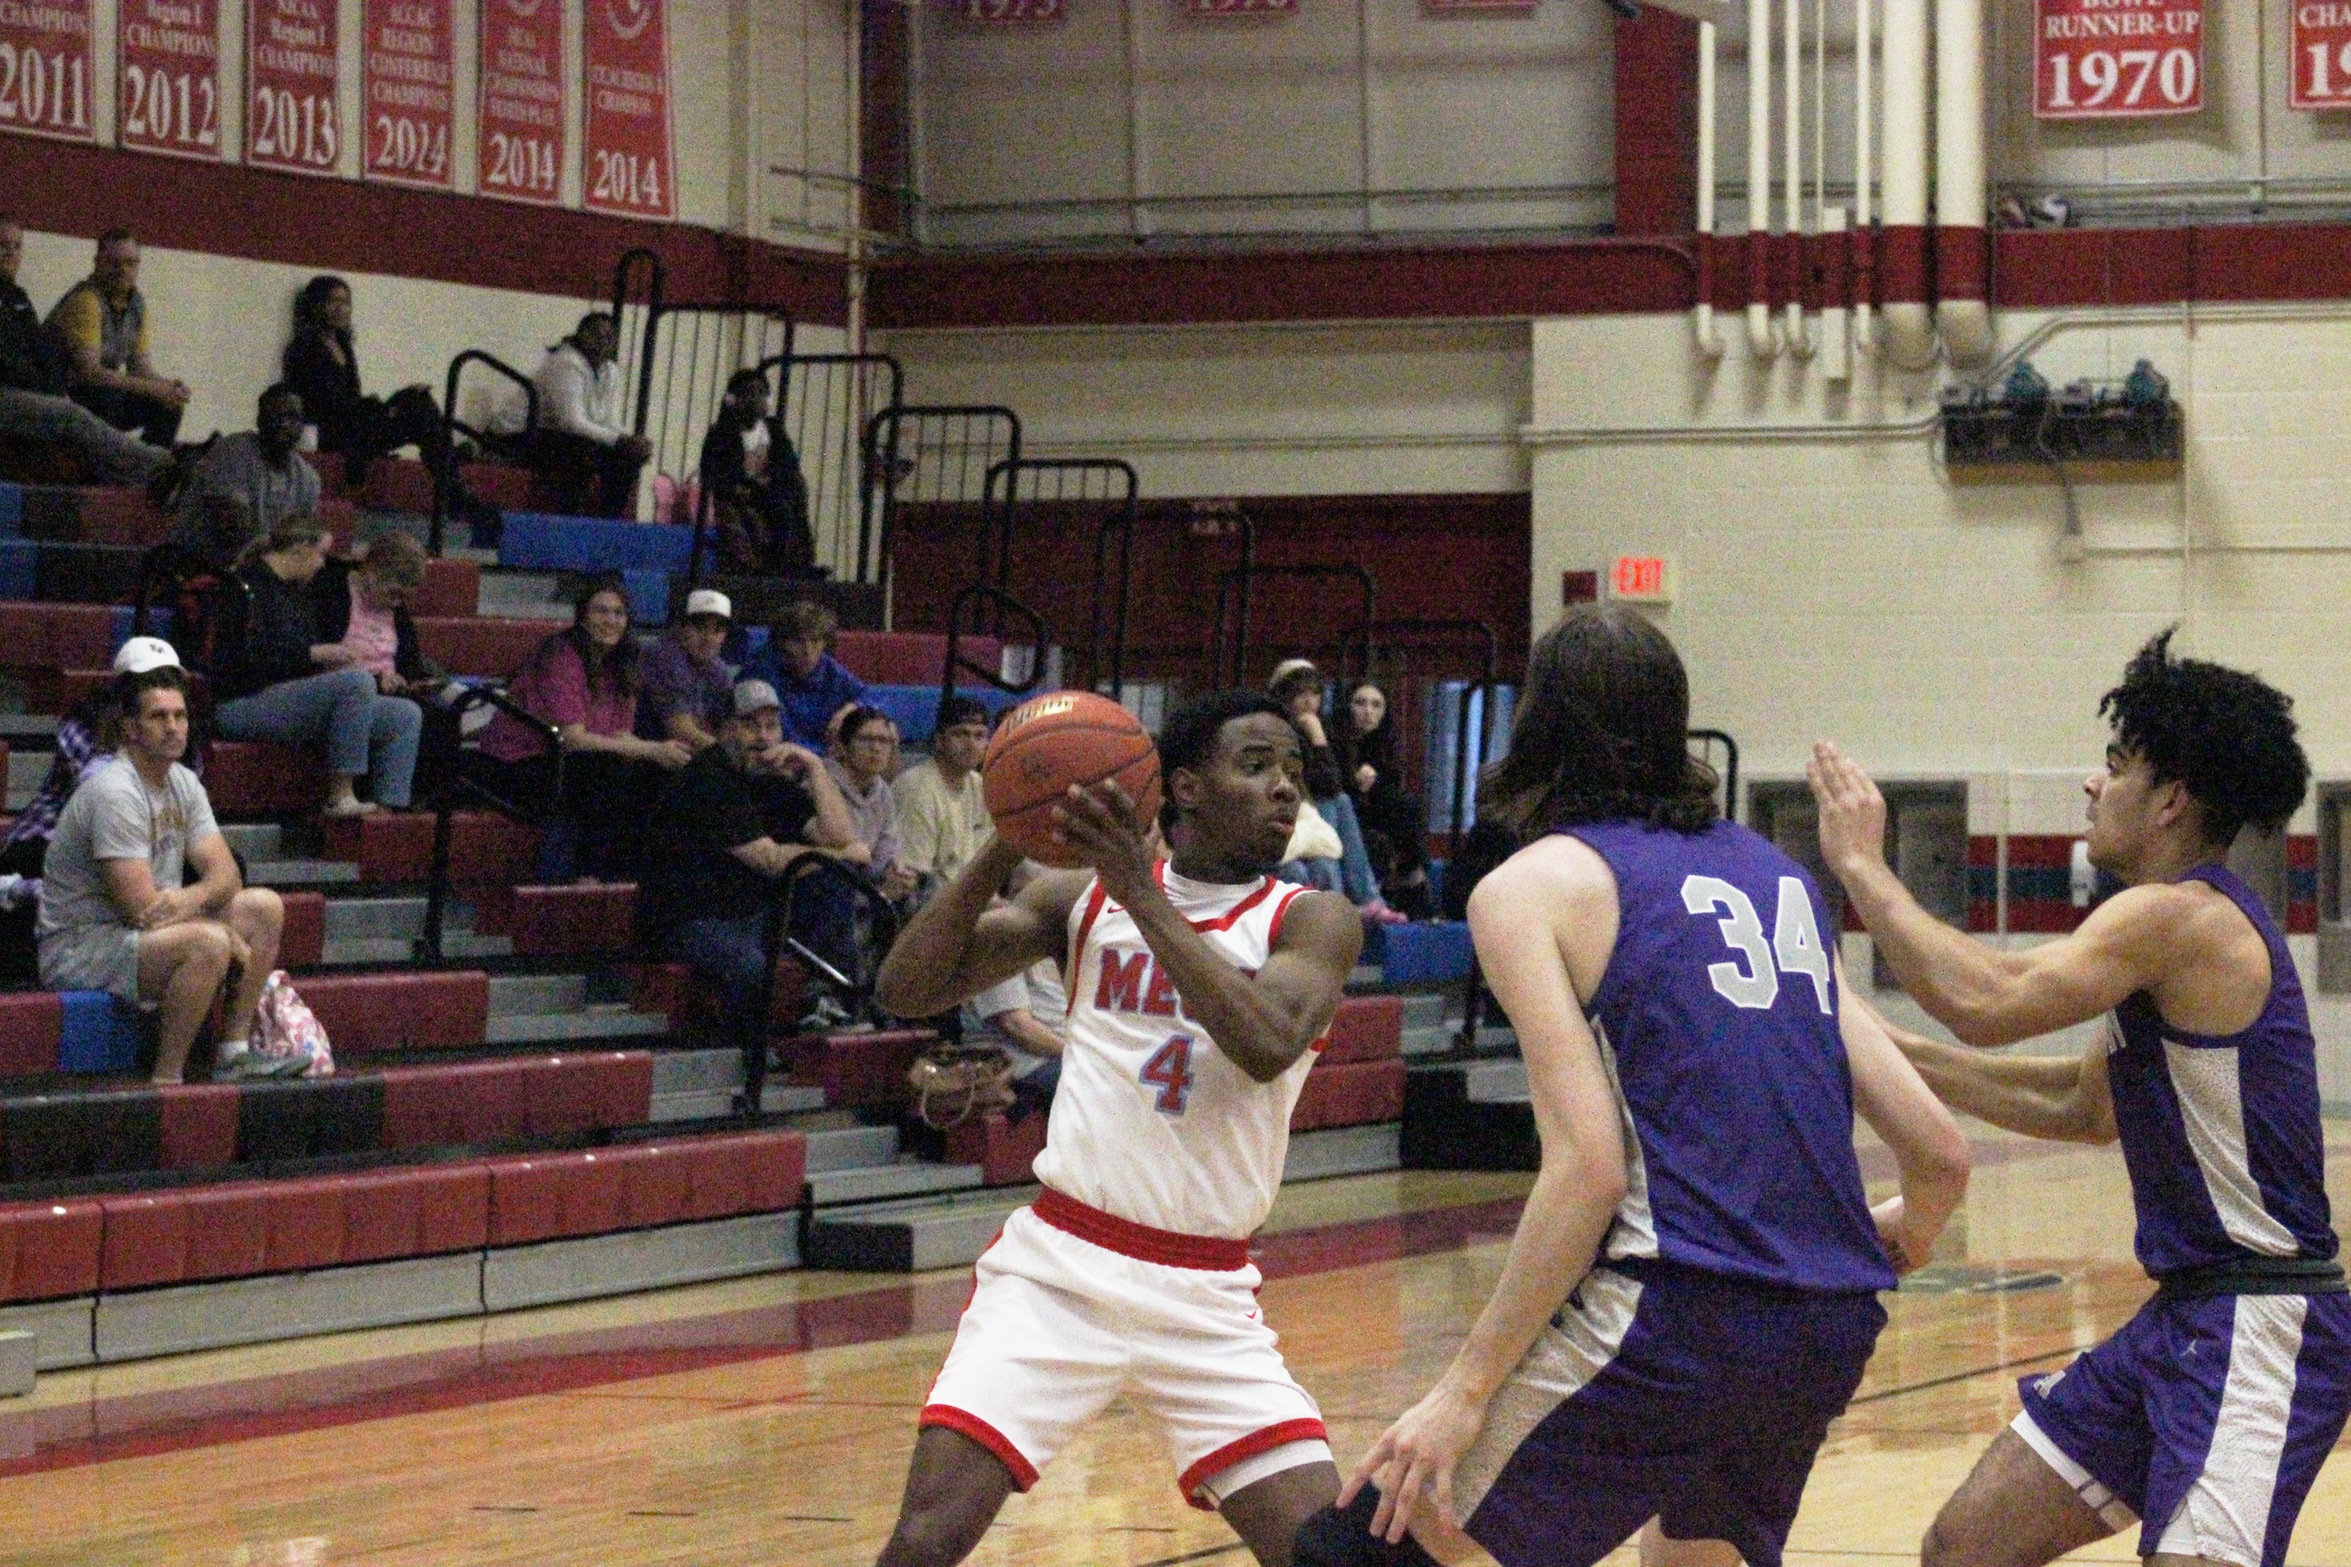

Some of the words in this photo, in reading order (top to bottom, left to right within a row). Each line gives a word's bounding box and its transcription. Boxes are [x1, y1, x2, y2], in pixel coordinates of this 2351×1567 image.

[2045, 10, 2199, 39] RUNNER-UP
[0, 42, 90, 129] 2011
[126, 65, 216, 146] 2012
[2050, 47, 2196, 107] 1970
[254, 85, 337, 166] 2013
[375, 114, 448, 176] 2014
[486, 131, 558, 192] 2014
[592, 148, 662, 207] 2014
[1680, 874, 1833, 1016] 34
[1138, 1033, 1196, 1117] 4
